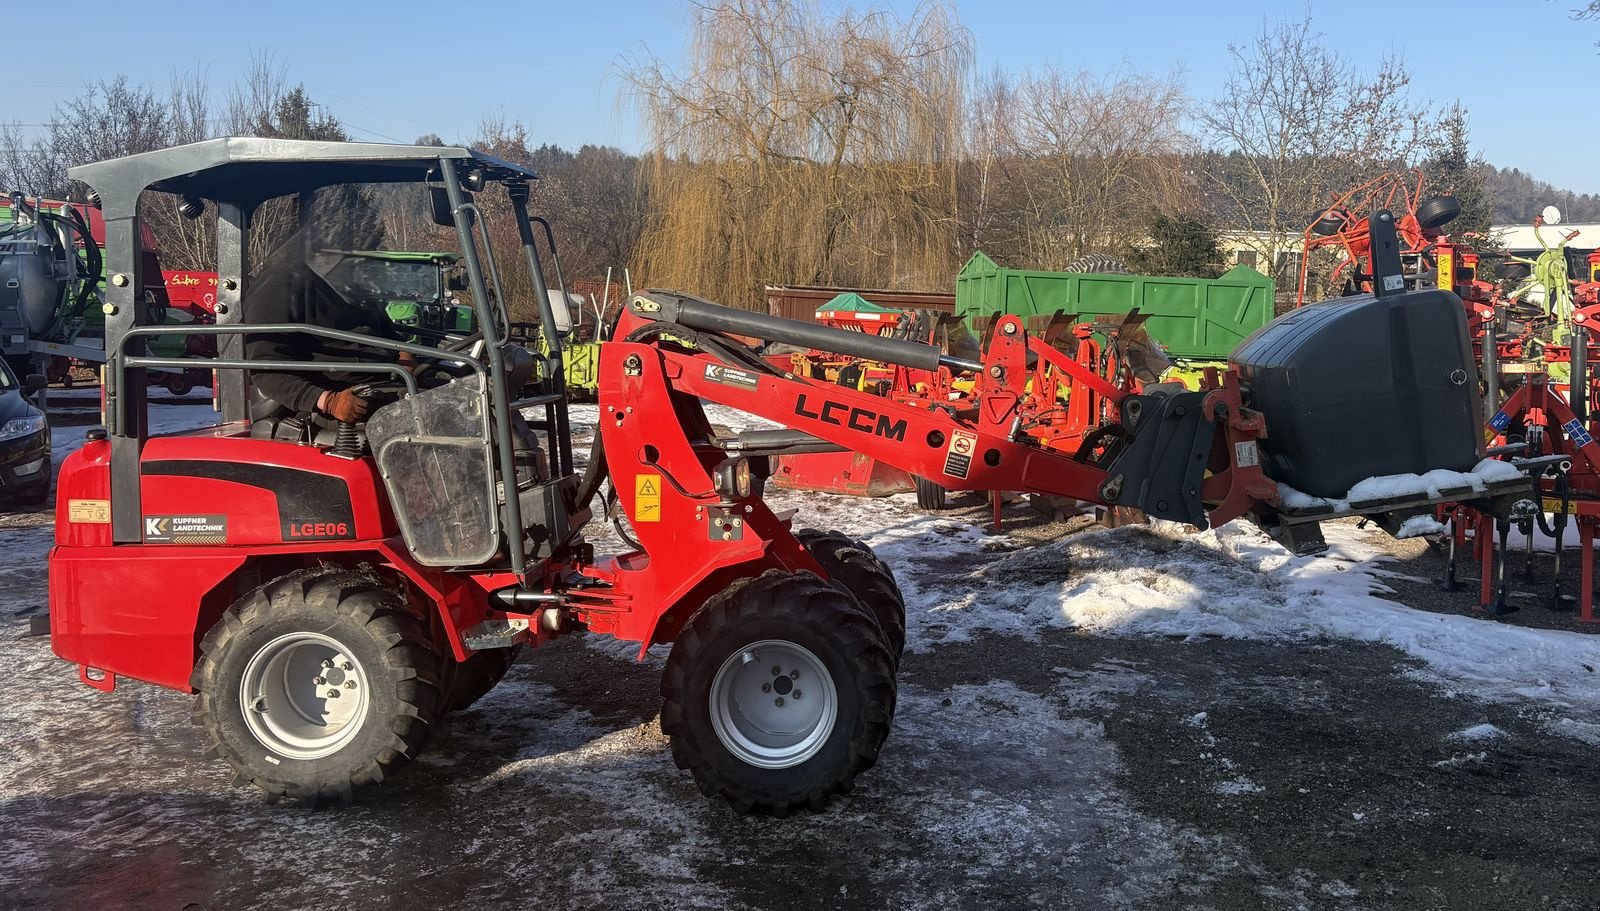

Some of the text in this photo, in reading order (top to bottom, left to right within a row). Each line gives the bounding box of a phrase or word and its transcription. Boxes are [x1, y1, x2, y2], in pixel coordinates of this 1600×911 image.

[172, 517, 207, 525] KUPFNER
[172, 524, 224, 532] LANDTECHNIK
[290, 522, 348, 537] LGE06
